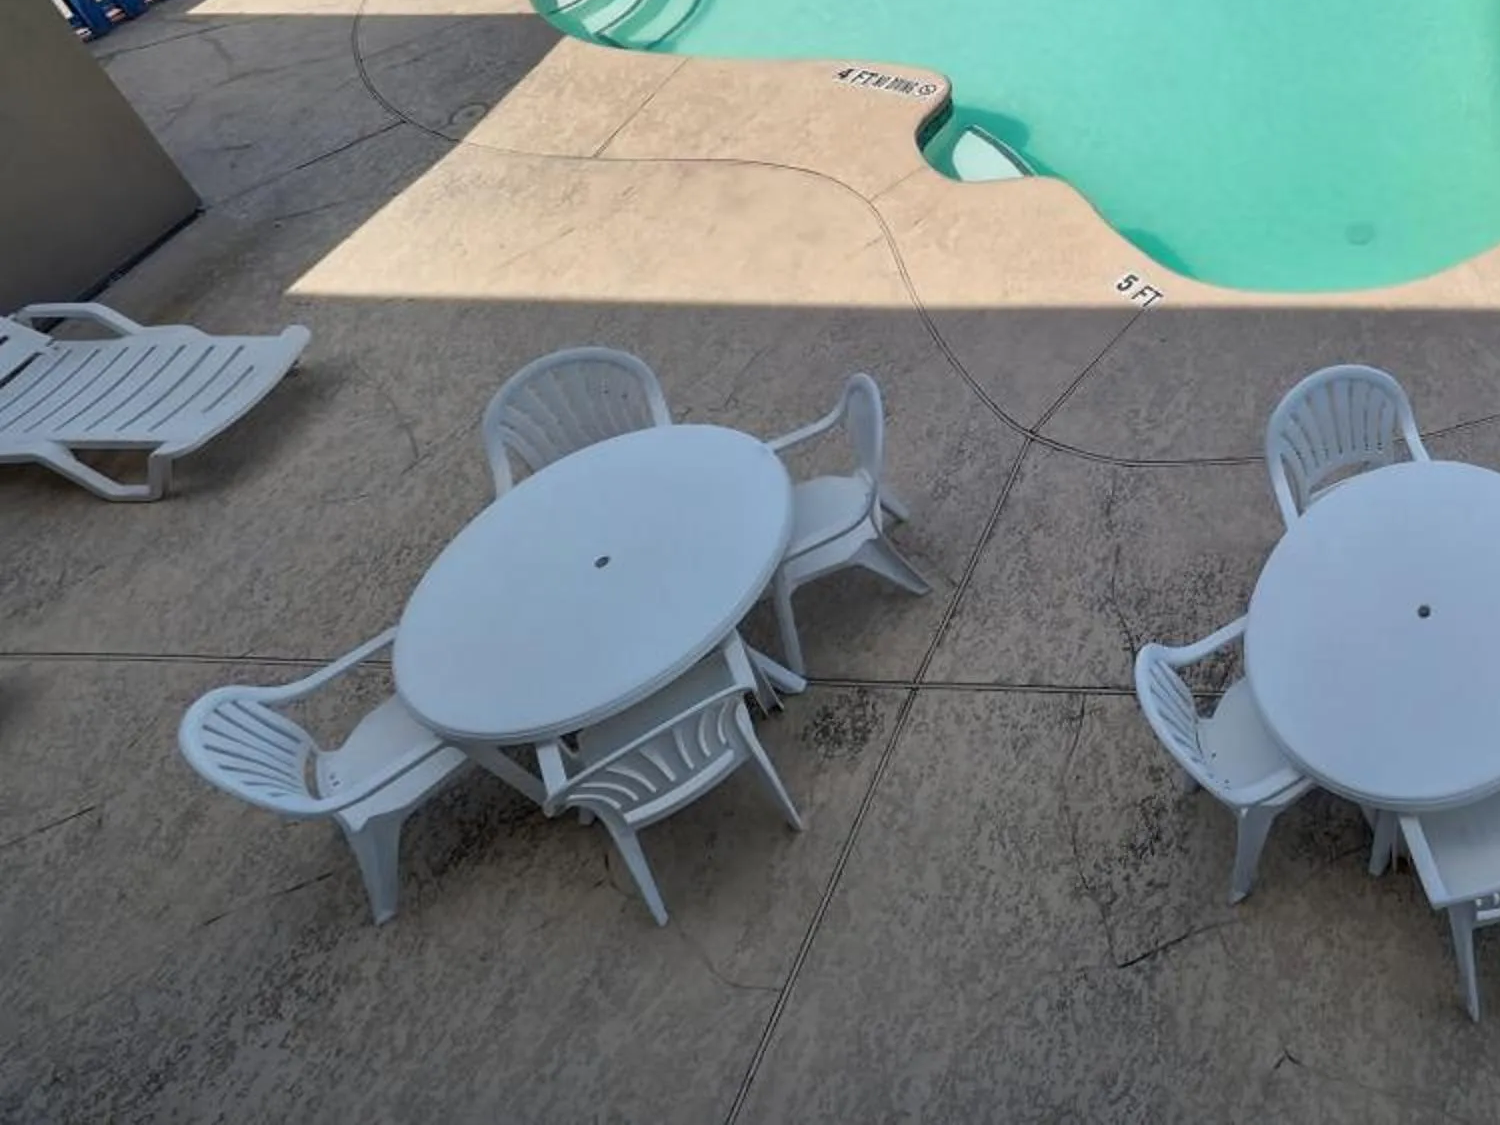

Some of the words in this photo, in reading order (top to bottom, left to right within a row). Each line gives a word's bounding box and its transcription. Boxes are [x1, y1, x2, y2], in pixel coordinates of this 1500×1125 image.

[837, 68, 855, 80] 4
[850, 70, 879, 85] FT
[1117, 274, 1139, 291] 5
[1131, 285, 1164, 307] FT
